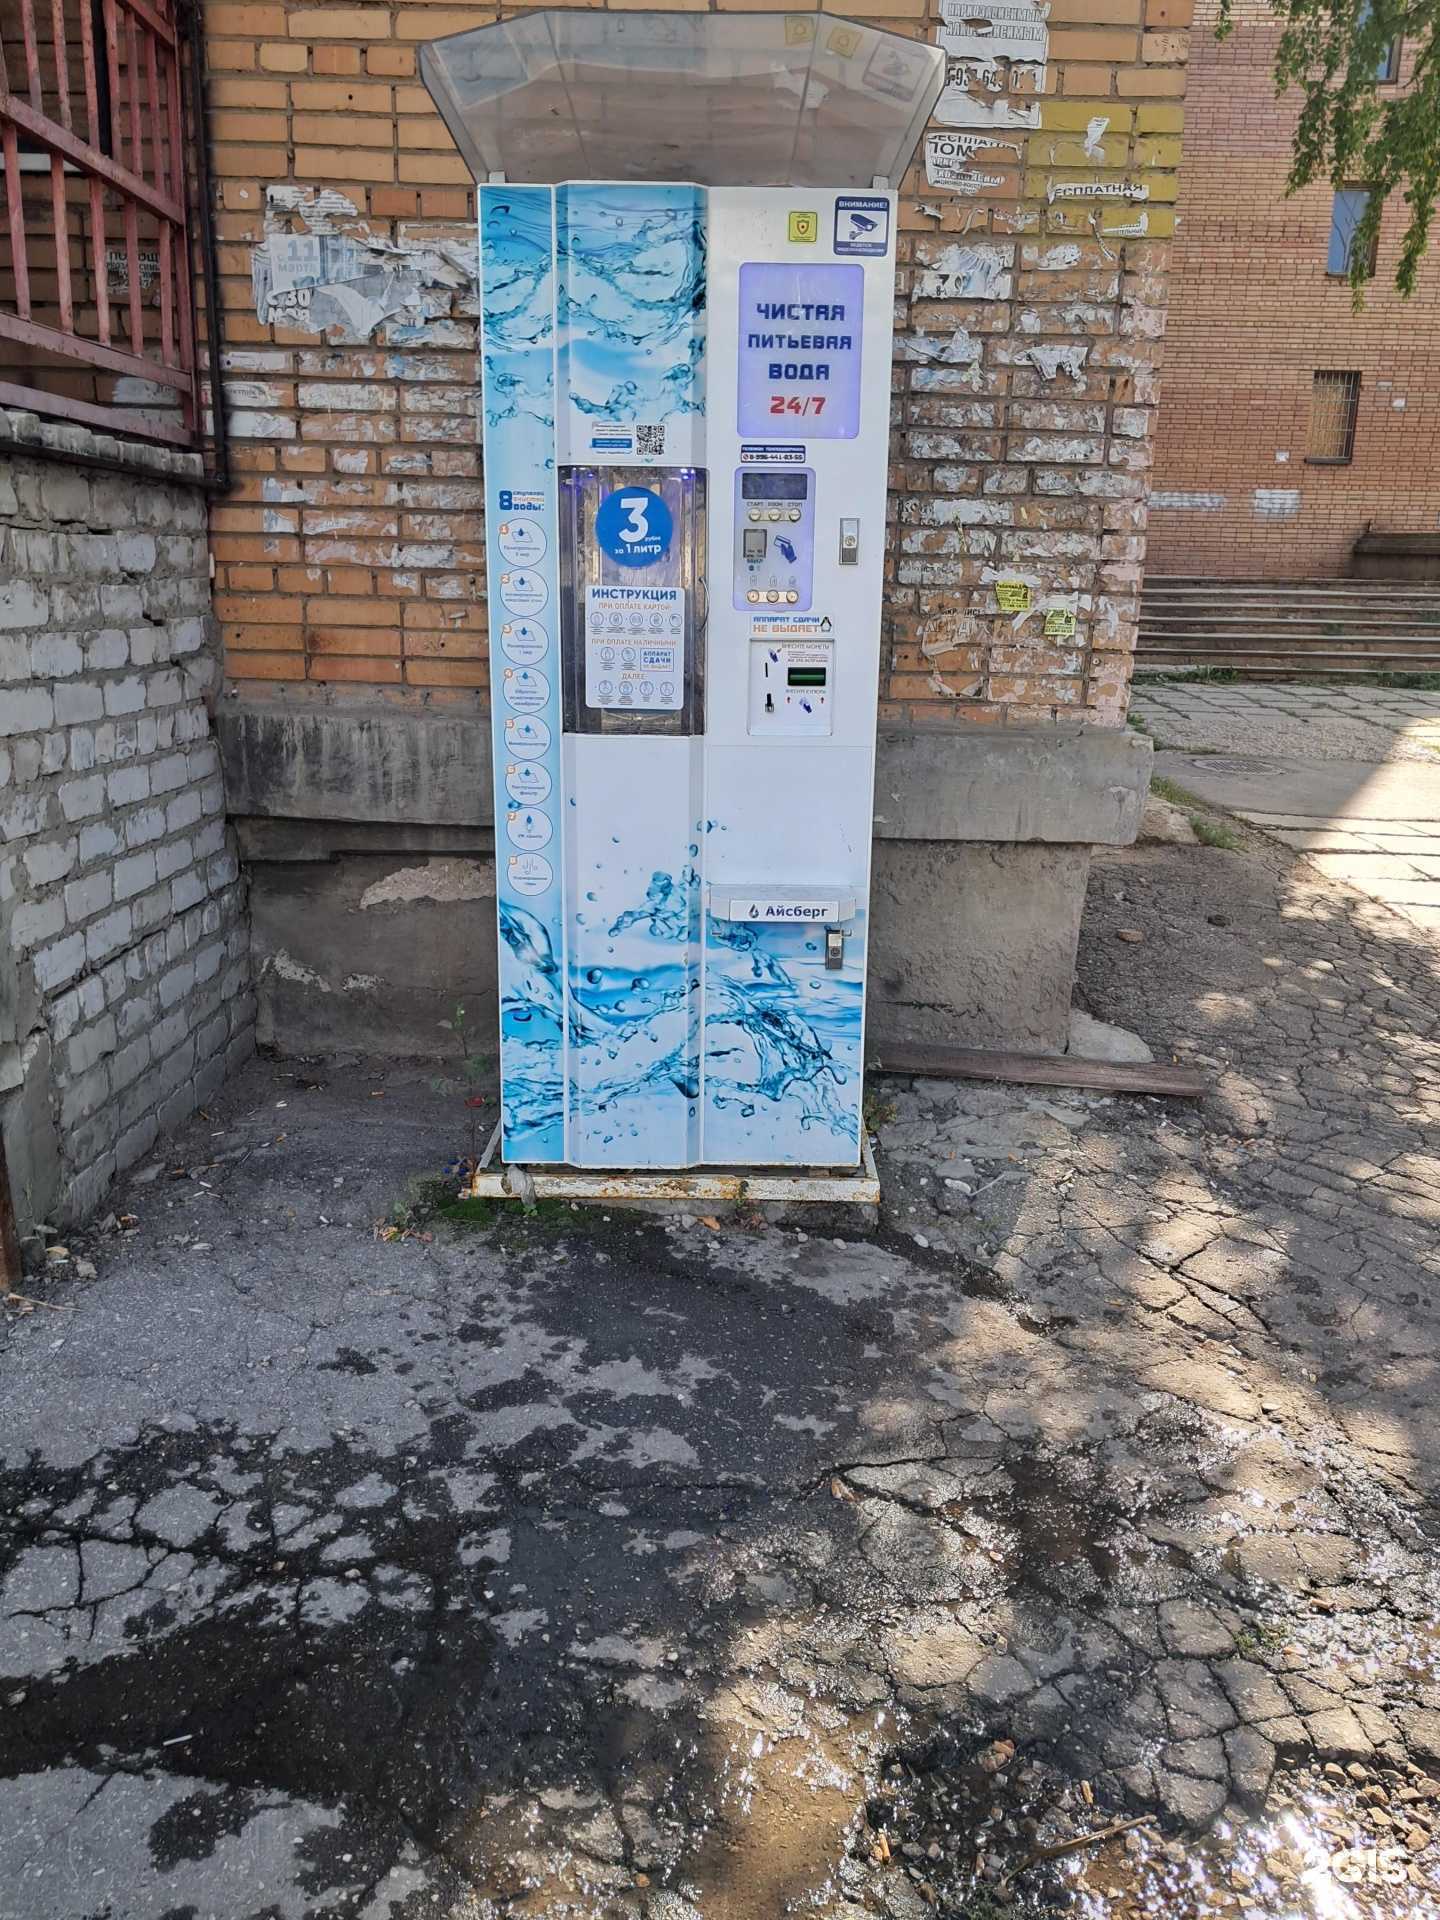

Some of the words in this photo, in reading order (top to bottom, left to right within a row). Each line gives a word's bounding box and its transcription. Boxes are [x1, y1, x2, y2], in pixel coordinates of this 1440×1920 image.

[838, 200, 888, 209] ВНИМАНИЕ!
[755, 303, 846, 321] ЧИСТАЯ
[747, 334, 852, 350] ПИТЬЕВАЯ
[768, 362, 830, 380] ВОДА
[769, 396, 826, 416] 24/7
[499, 490, 513, 510] 8
[618, 497, 649, 543] 3
[625, 543, 632, 553] 1
[633, 543, 662, 555] литр
[591, 588, 677, 601] ИНСТРУКЦИЯ
[793, 616, 820, 624] СДАЧИ
[753, 624, 767, 632] НЕ
[765, 905, 829, 919] Айсберг
